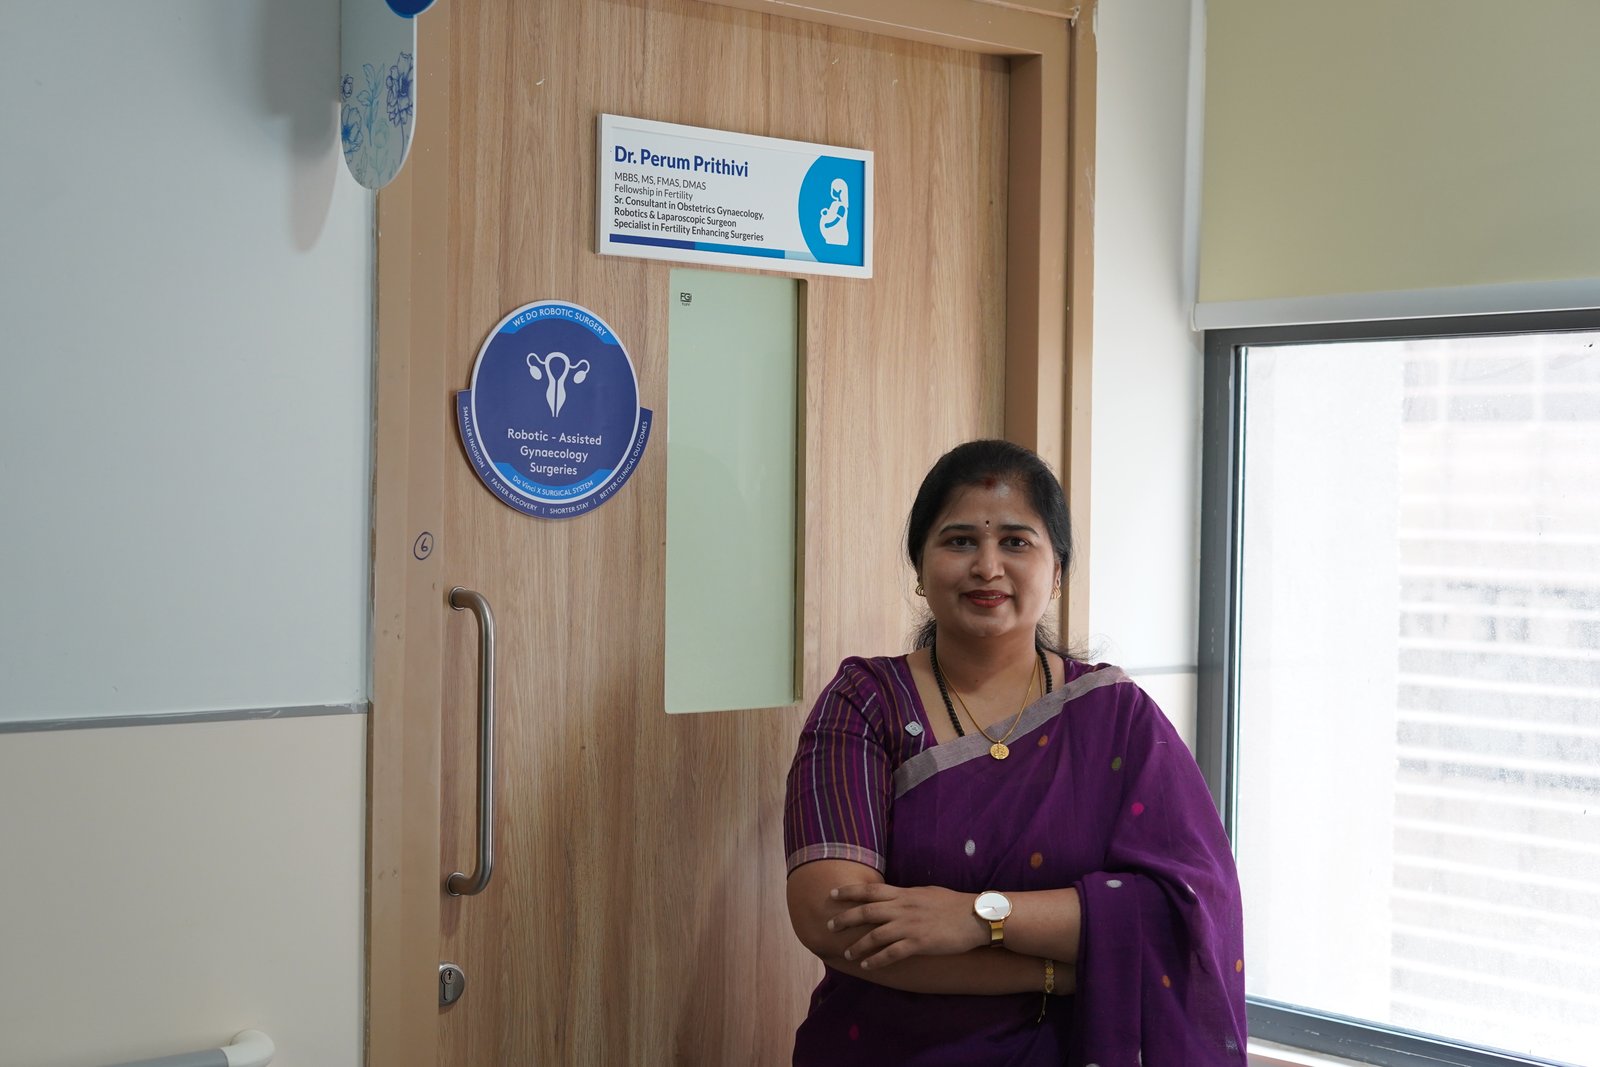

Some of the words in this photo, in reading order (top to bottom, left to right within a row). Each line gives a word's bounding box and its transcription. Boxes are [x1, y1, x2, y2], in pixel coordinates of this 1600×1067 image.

[615, 145, 637, 164] Dr.
[640, 148, 690, 171] Perum
[694, 155, 748, 177] Prithivi
[614, 171, 640, 183] MBBS,
[641, 175, 656, 185] MS,
[657, 176, 682, 188] FMAS,
[682, 179, 707, 190] DMAS
[614, 183, 655, 197] Fellowship
[656, 187, 663, 197] in
[664, 189, 693, 201] Fertility
[614, 195, 624, 205] Sr.
[625, 196, 667, 209] Consultant
[669, 201, 676, 210] in
[677, 202, 716, 214] Obstetrics
[717, 206, 765, 220] Gynaecology,
[614, 206, 648, 219] Robotics
[649, 210, 656, 219] &
[657, 211, 706, 225] Laparoscopic
[706, 216, 737, 228] Surgeon
[614, 218, 651, 231] Specialist
[652, 222, 660, 231] in
[660, 223, 691, 235] Fertility
[692, 226, 730, 239] Enhancing
[730, 230, 764, 242] Surgeries
[512, 315, 526, 327] WE
[526, 310, 538, 320] DO
[539, 307, 574, 318] ROBOTIC
[574, 311, 607, 336] SURGERY
[462, 406, 473, 438] SMALLER
[469, 438, 485, 469] INCISION
[507, 428, 549, 441] Robotic
[559, 432, 602, 445] Assisted
[520, 445, 589, 463] Gynaecology
[599, 482, 618, 499] BETTER
[616, 457, 636, 483] CLINICAL
[633, 420, 648, 457] OUTCOMES
[530, 462, 578, 477] Surgeries
[490, 478, 509, 497] FASTER
[508, 493, 538, 512] RECOVERY
[512, 475, 521, 484] Da
[522, 480, 537, 492] Vinci
[541, 489, 572, 497] SURGICAL
[572, 480, 594, 494] SYSTEM
[549, 505, 576, 514] SHORTER
[576, 501, 590, 511] STAY
